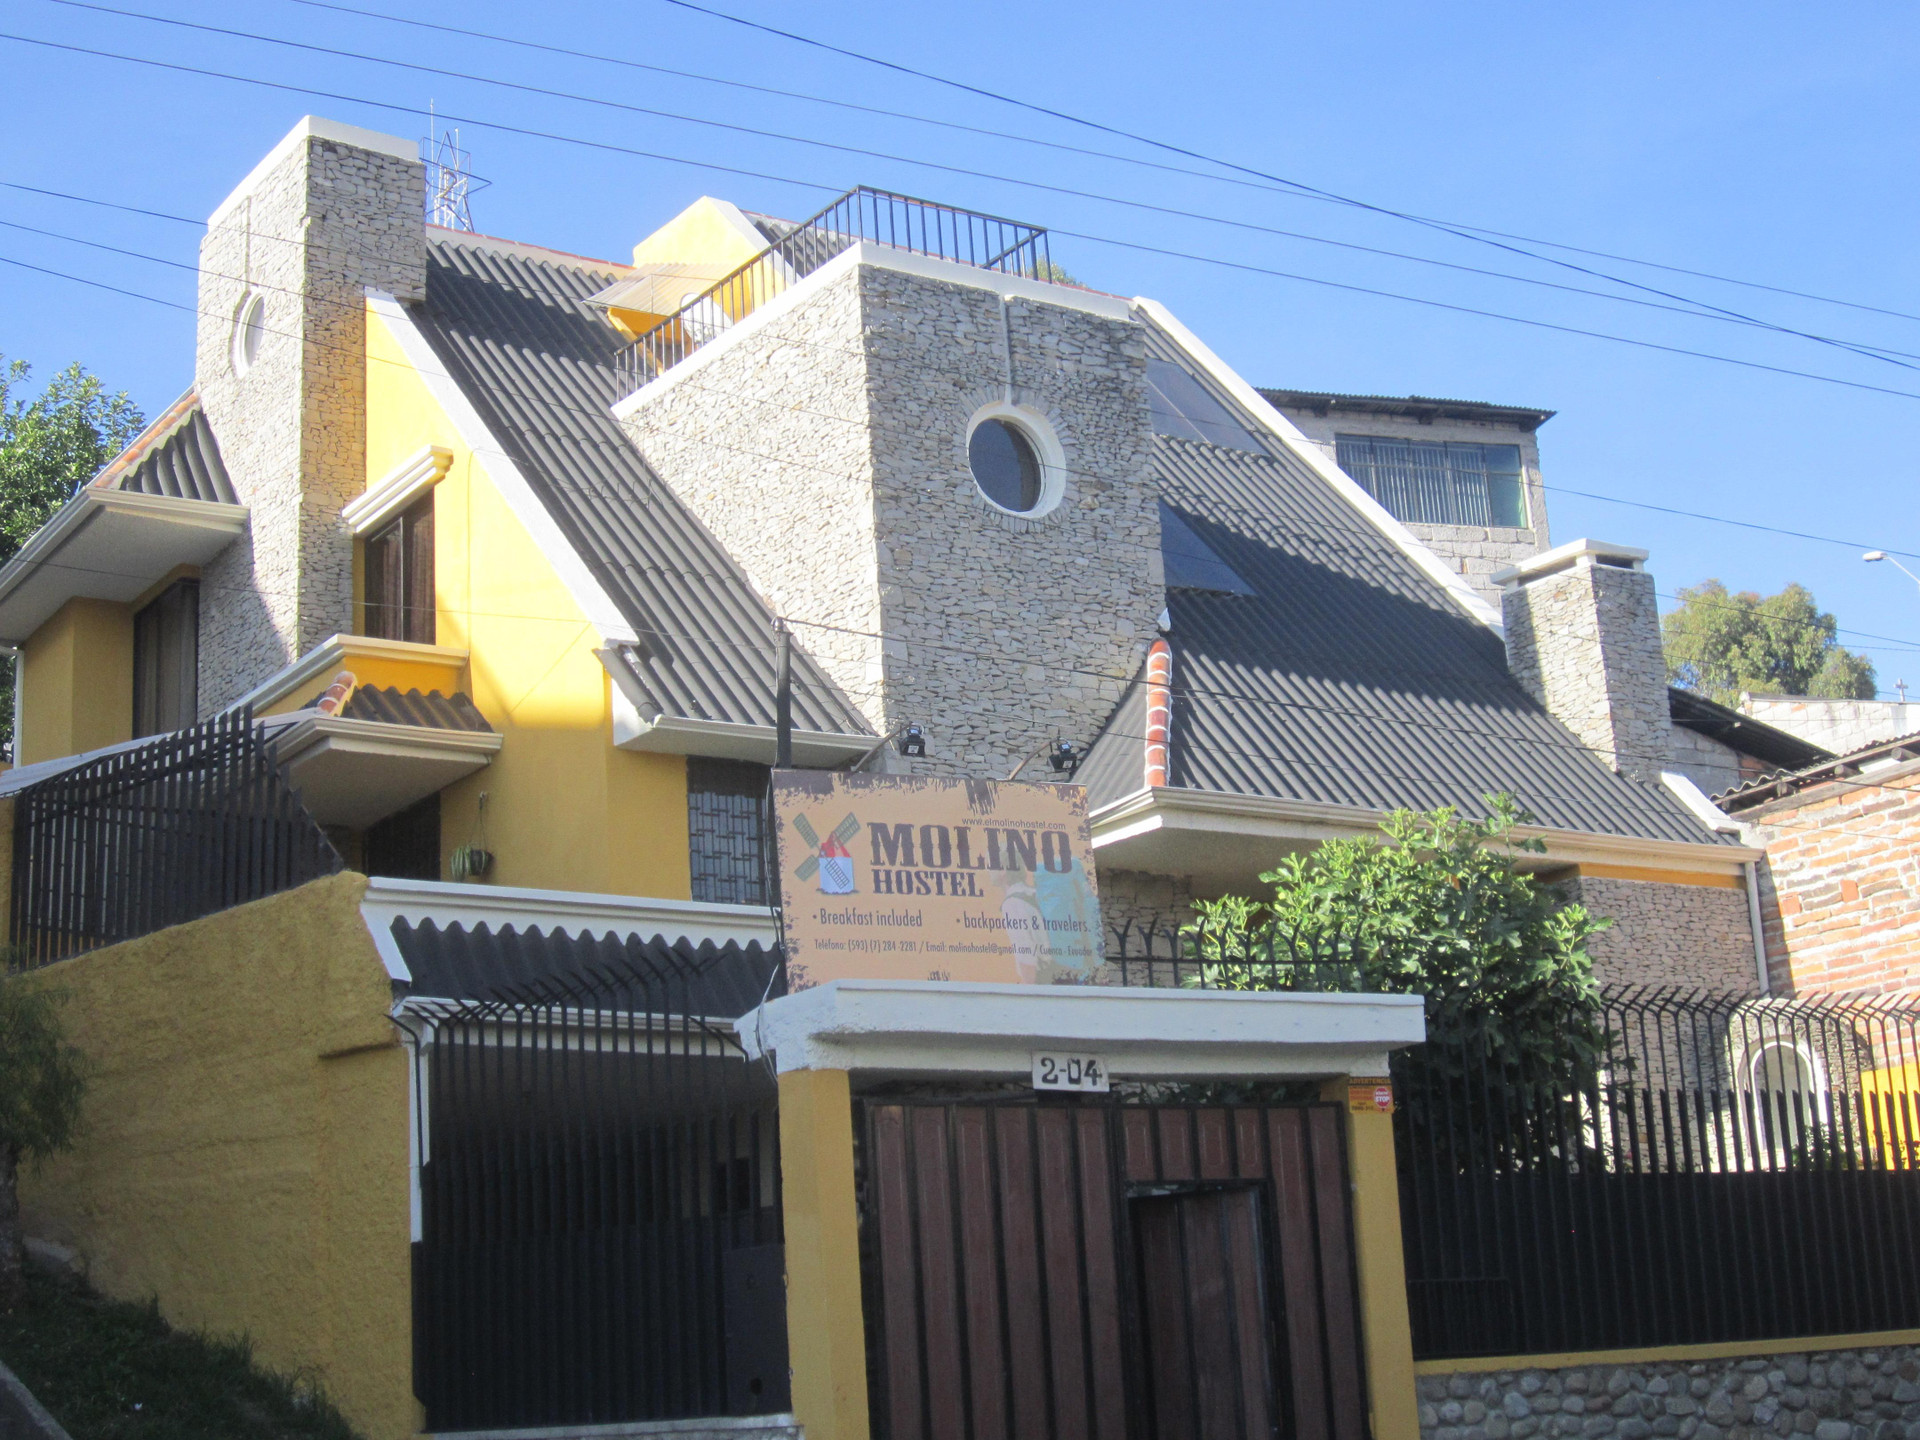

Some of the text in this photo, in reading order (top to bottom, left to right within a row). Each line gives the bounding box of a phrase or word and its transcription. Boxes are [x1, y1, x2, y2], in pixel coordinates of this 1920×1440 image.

[961, 817, 1066, 830] www.elmolinohostel.com
[866, 822, 1073, 874] MOLINO
[871, 869, 984, 897] HOSTEL
[820, 907, 923, 927] Breakfast included
[963, 910, 1028, 932] backpackers
[1031, 915, 1040, 930] &
[1041, 1056, 1103, 1086] 2-04
